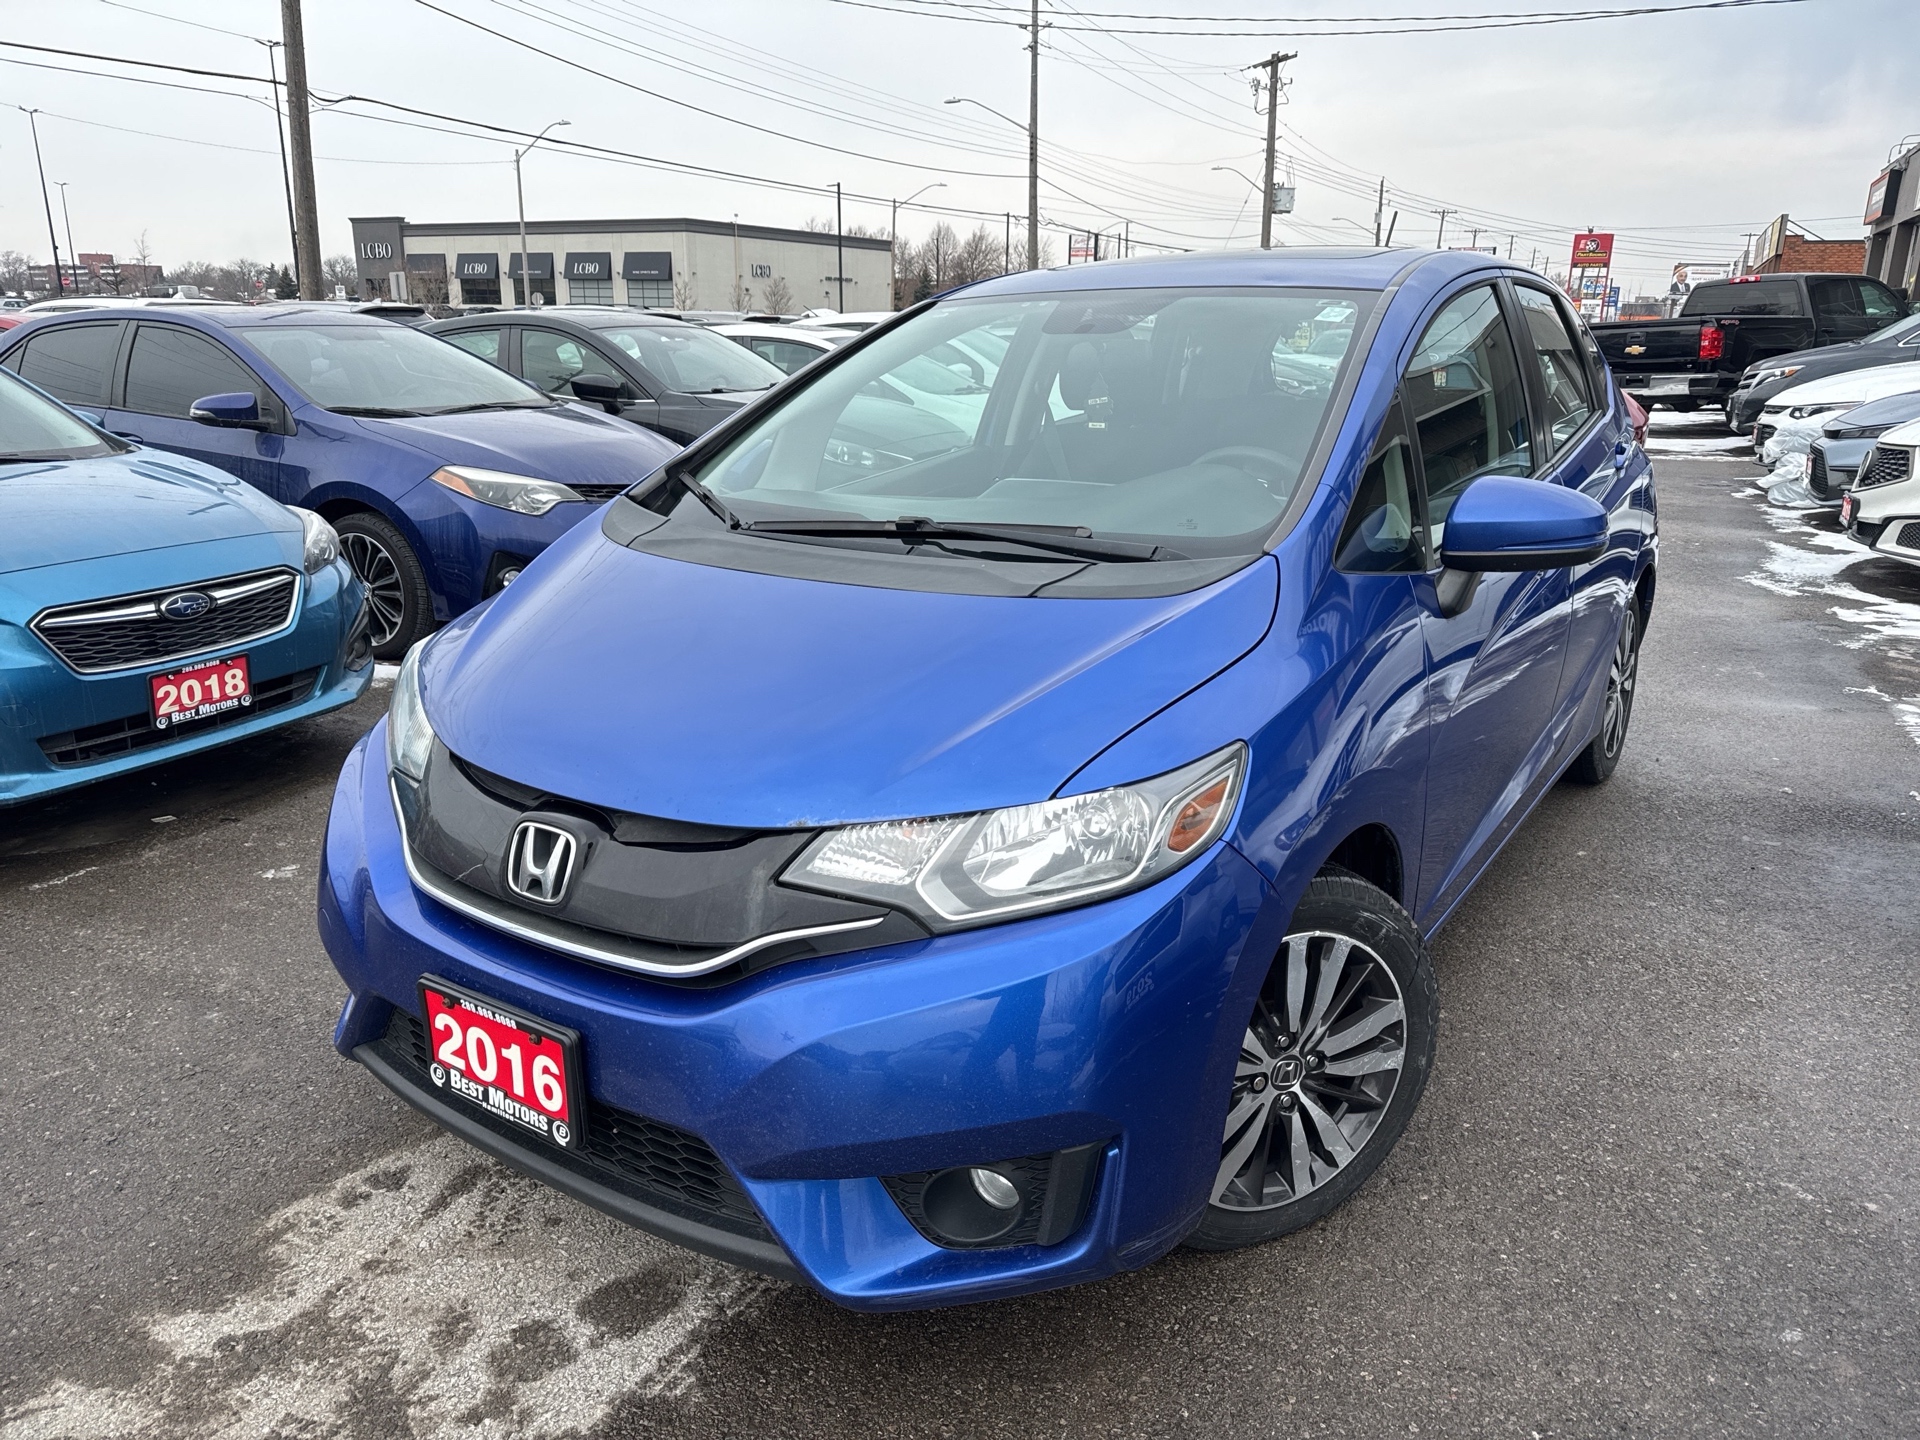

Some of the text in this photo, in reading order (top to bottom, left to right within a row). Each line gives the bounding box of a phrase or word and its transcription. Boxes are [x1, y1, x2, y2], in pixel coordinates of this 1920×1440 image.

[361, 242, 392, 259] LCBO
[464, 262, 488, 274] LCBO
[573, 262, 599, 275] LCBO
[751, 263, 771, 278] LCBO
[156, 668, 246, 716] 2018
[171, 698, 239, 723] BEST MOTORS
[434, 1012, 563, 1113] 2016
[450, 1068, 548, 1131] BEST MOTORS
